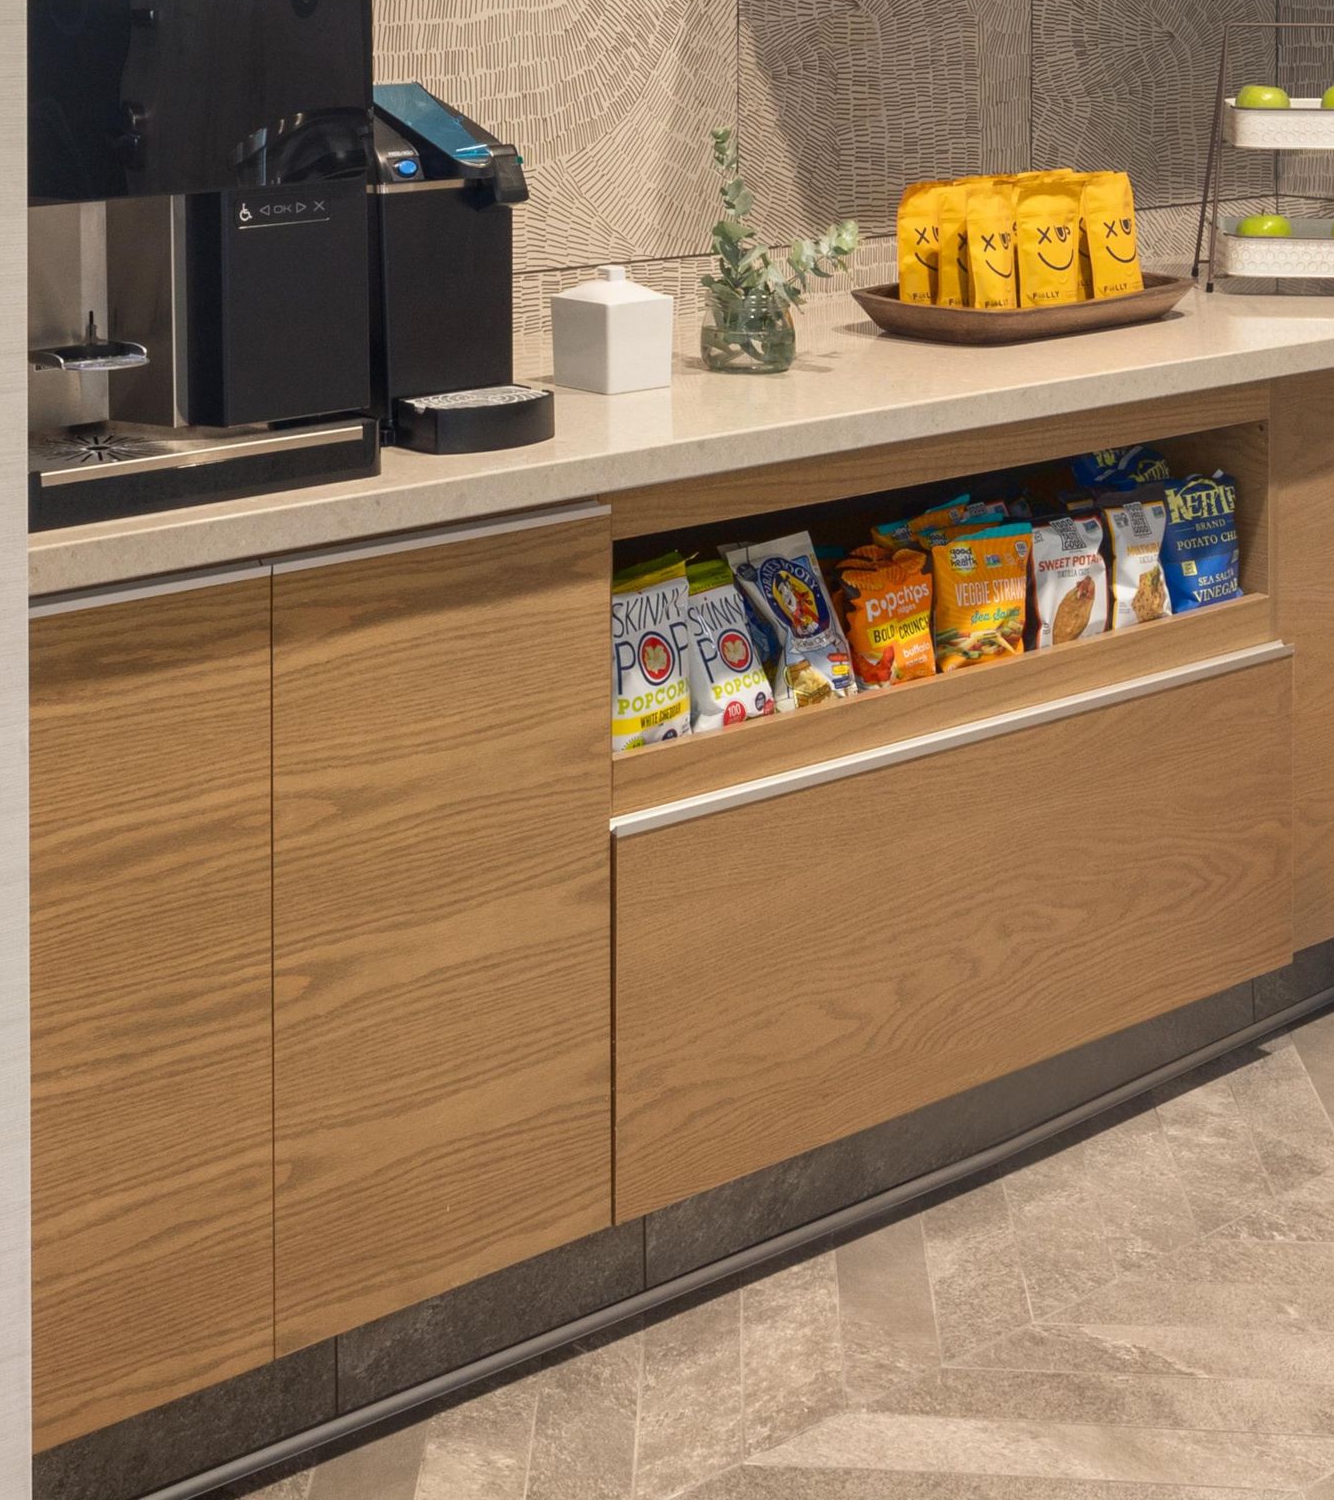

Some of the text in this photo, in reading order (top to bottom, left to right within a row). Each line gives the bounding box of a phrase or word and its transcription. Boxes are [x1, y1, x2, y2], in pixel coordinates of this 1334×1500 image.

[273, 204, 292, 214] OK
[1165, 485, 1235, 524] KETTLE
[1196, 518, 1226, 532] BRAND
[1177, 535, 1217, 551] POTATO
[1038, 559, 1069, 572] SWEET
[866, 583, 929, 623] popchips
[955, 581, 990, 607] VEGGIE
[613, 585, 688, 639] SKINNY
[873, 616, 930, 644] BOLD CRUNCH
[614, 621, 688, 695] POP
